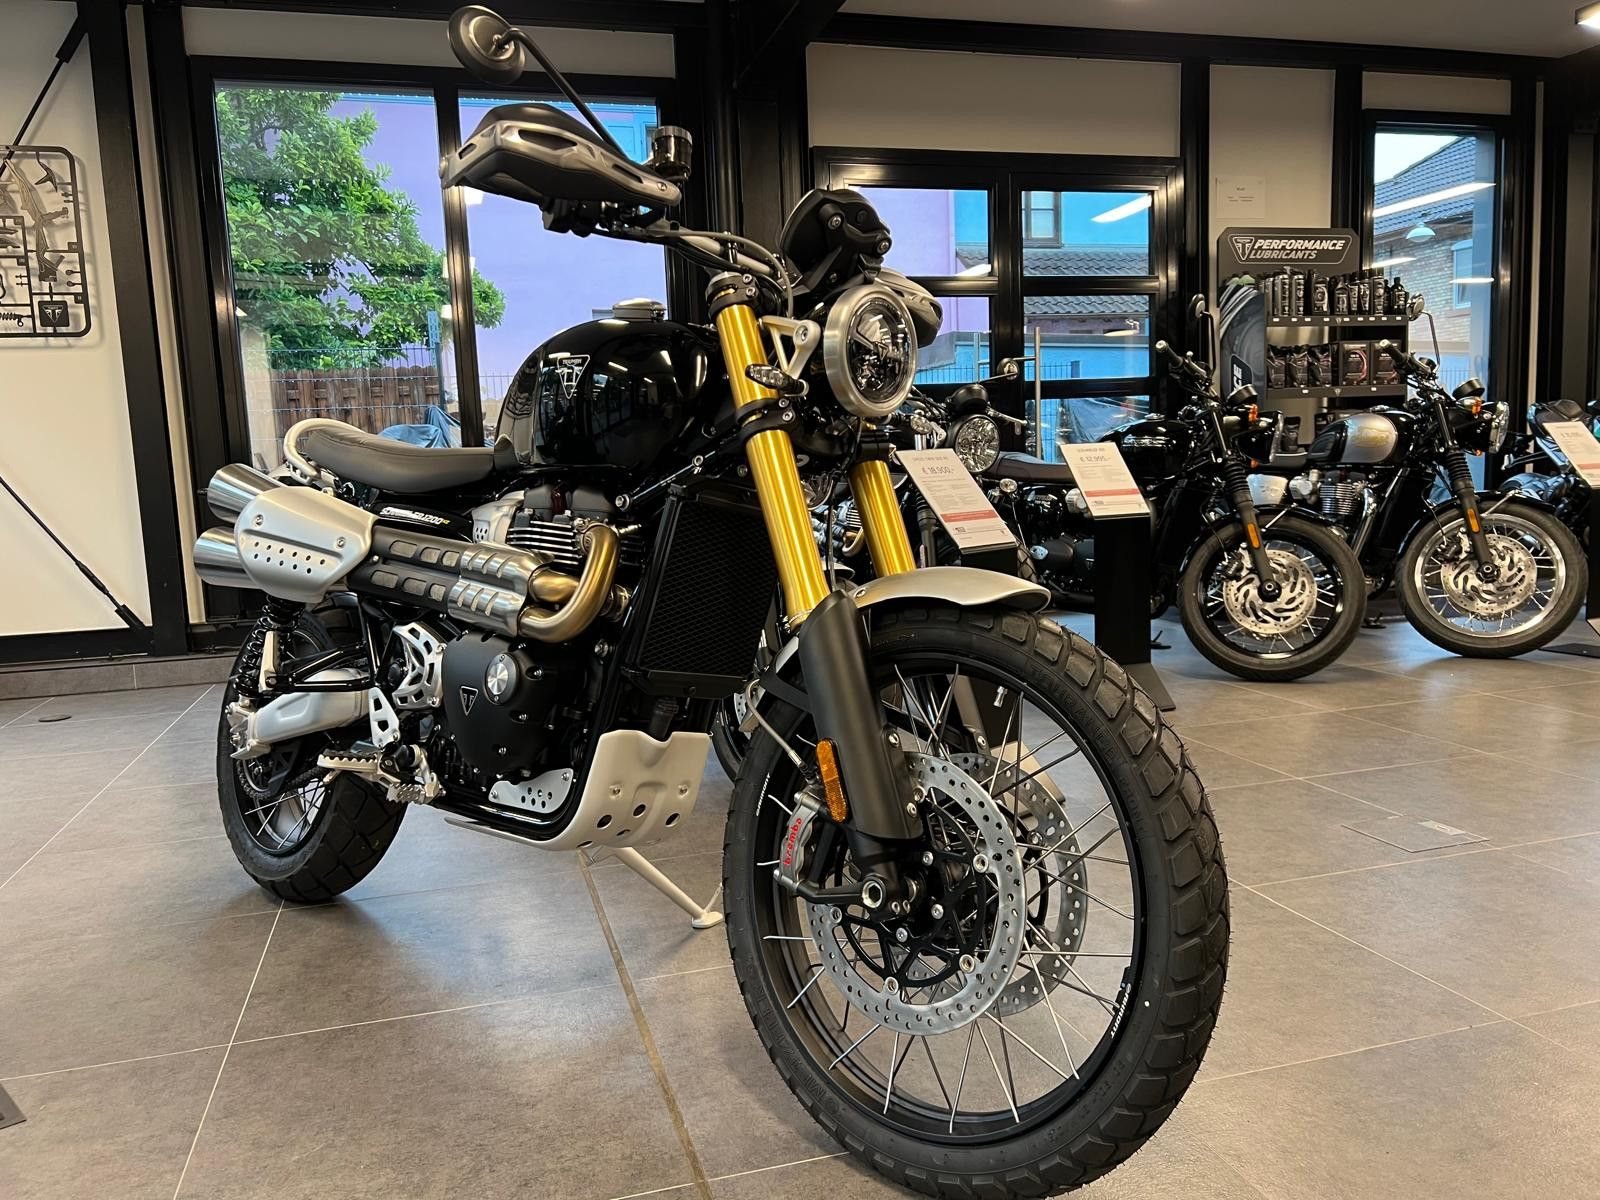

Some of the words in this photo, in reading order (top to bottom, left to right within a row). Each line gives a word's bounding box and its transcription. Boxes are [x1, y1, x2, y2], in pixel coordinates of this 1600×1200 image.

[1253, 239, 1346, 250] PERFORMANCE
[1249, 250, 1318, 259] LUBRICANTS
[784, 818, 802, 865] brembo
